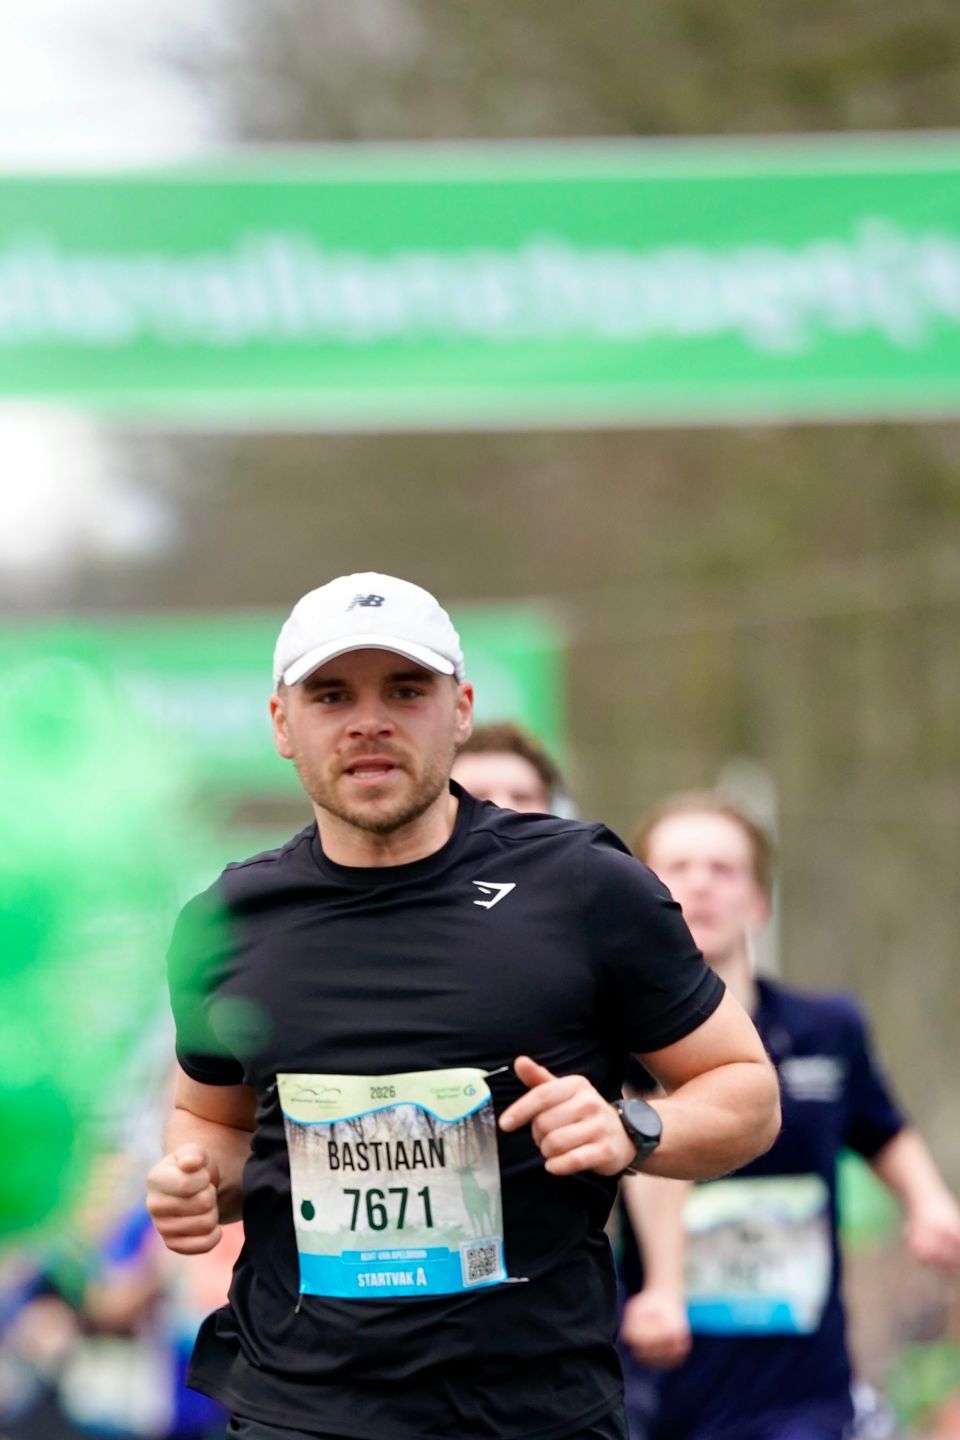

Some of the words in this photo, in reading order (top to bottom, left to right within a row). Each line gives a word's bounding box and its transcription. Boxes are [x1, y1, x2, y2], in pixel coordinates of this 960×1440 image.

[370, 1085, 396, 1099] 2026
[327, 1137, 446, 1171] BASTIAAN
[343, 1186, 434, 1231] 7671
[358, 1271, 415, 1288] STARTVAK
[416, 1267, 427, 1286] A
